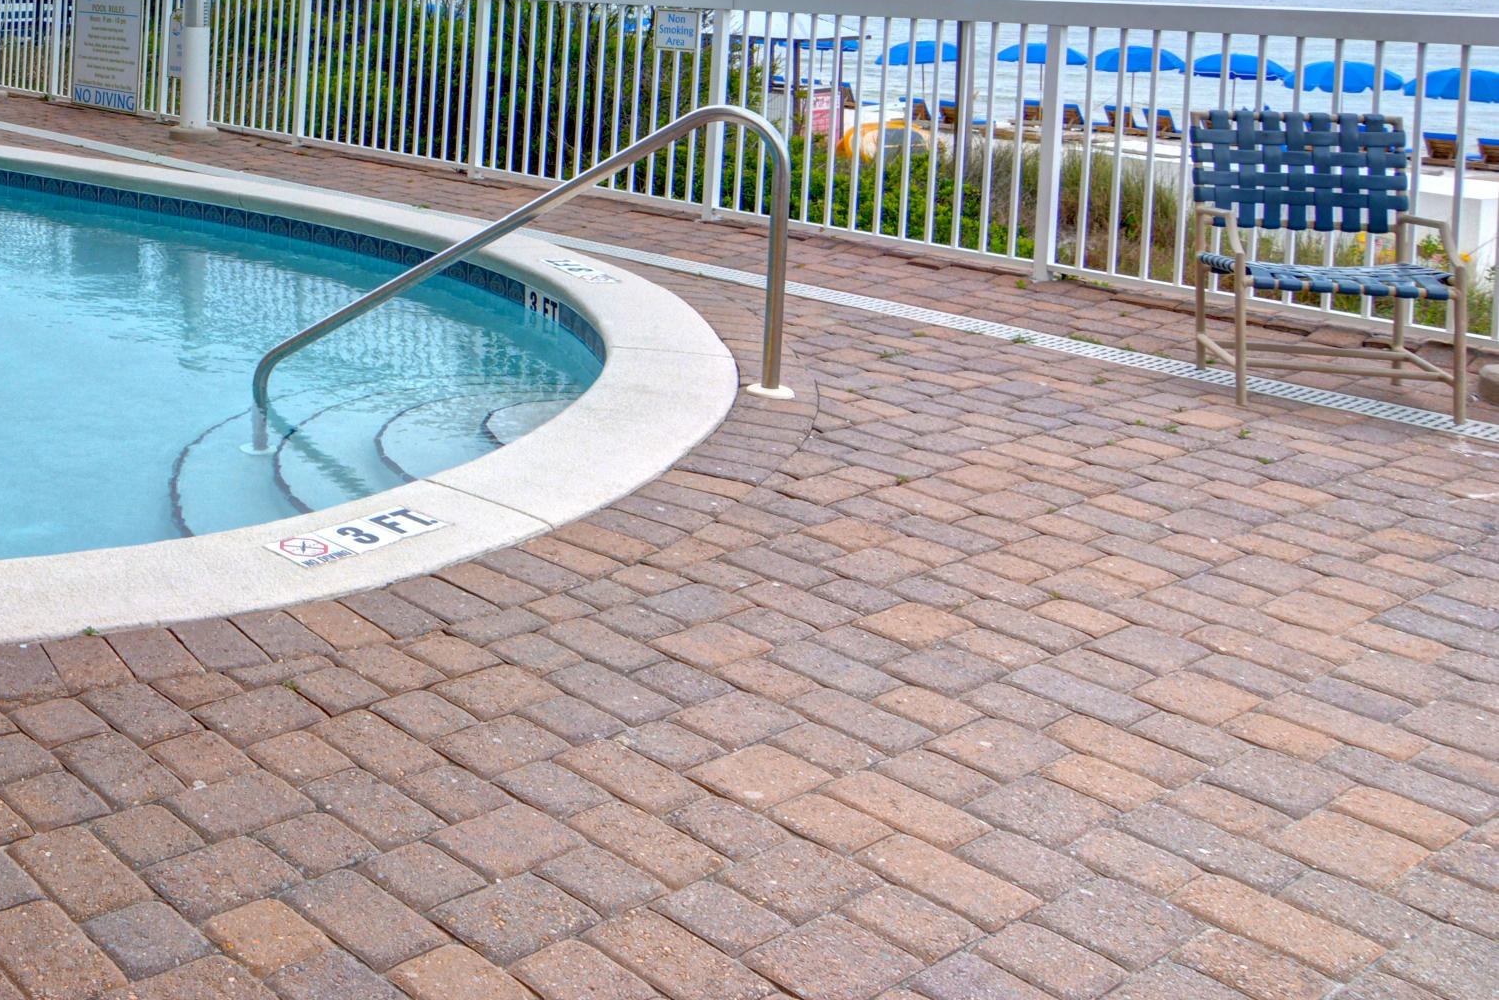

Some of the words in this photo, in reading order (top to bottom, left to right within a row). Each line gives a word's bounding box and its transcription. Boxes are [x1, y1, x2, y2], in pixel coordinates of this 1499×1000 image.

[667, 13, 686, 23] Non
[659, 24, 694, 38] Smoking
[665, 37, 685, 46] Area
[75, 87, 92, 103] NO
[94, 90, 135, 111] DIVING
[530, 291, 538, 312] 3
[543, 297, 558, 321] FT
[336, 526, 380, 544] 3
[369, 508, 438, 534] FT.
[301, 557, 319, 567] NO
[320, 550, 353, 564] DIVING
